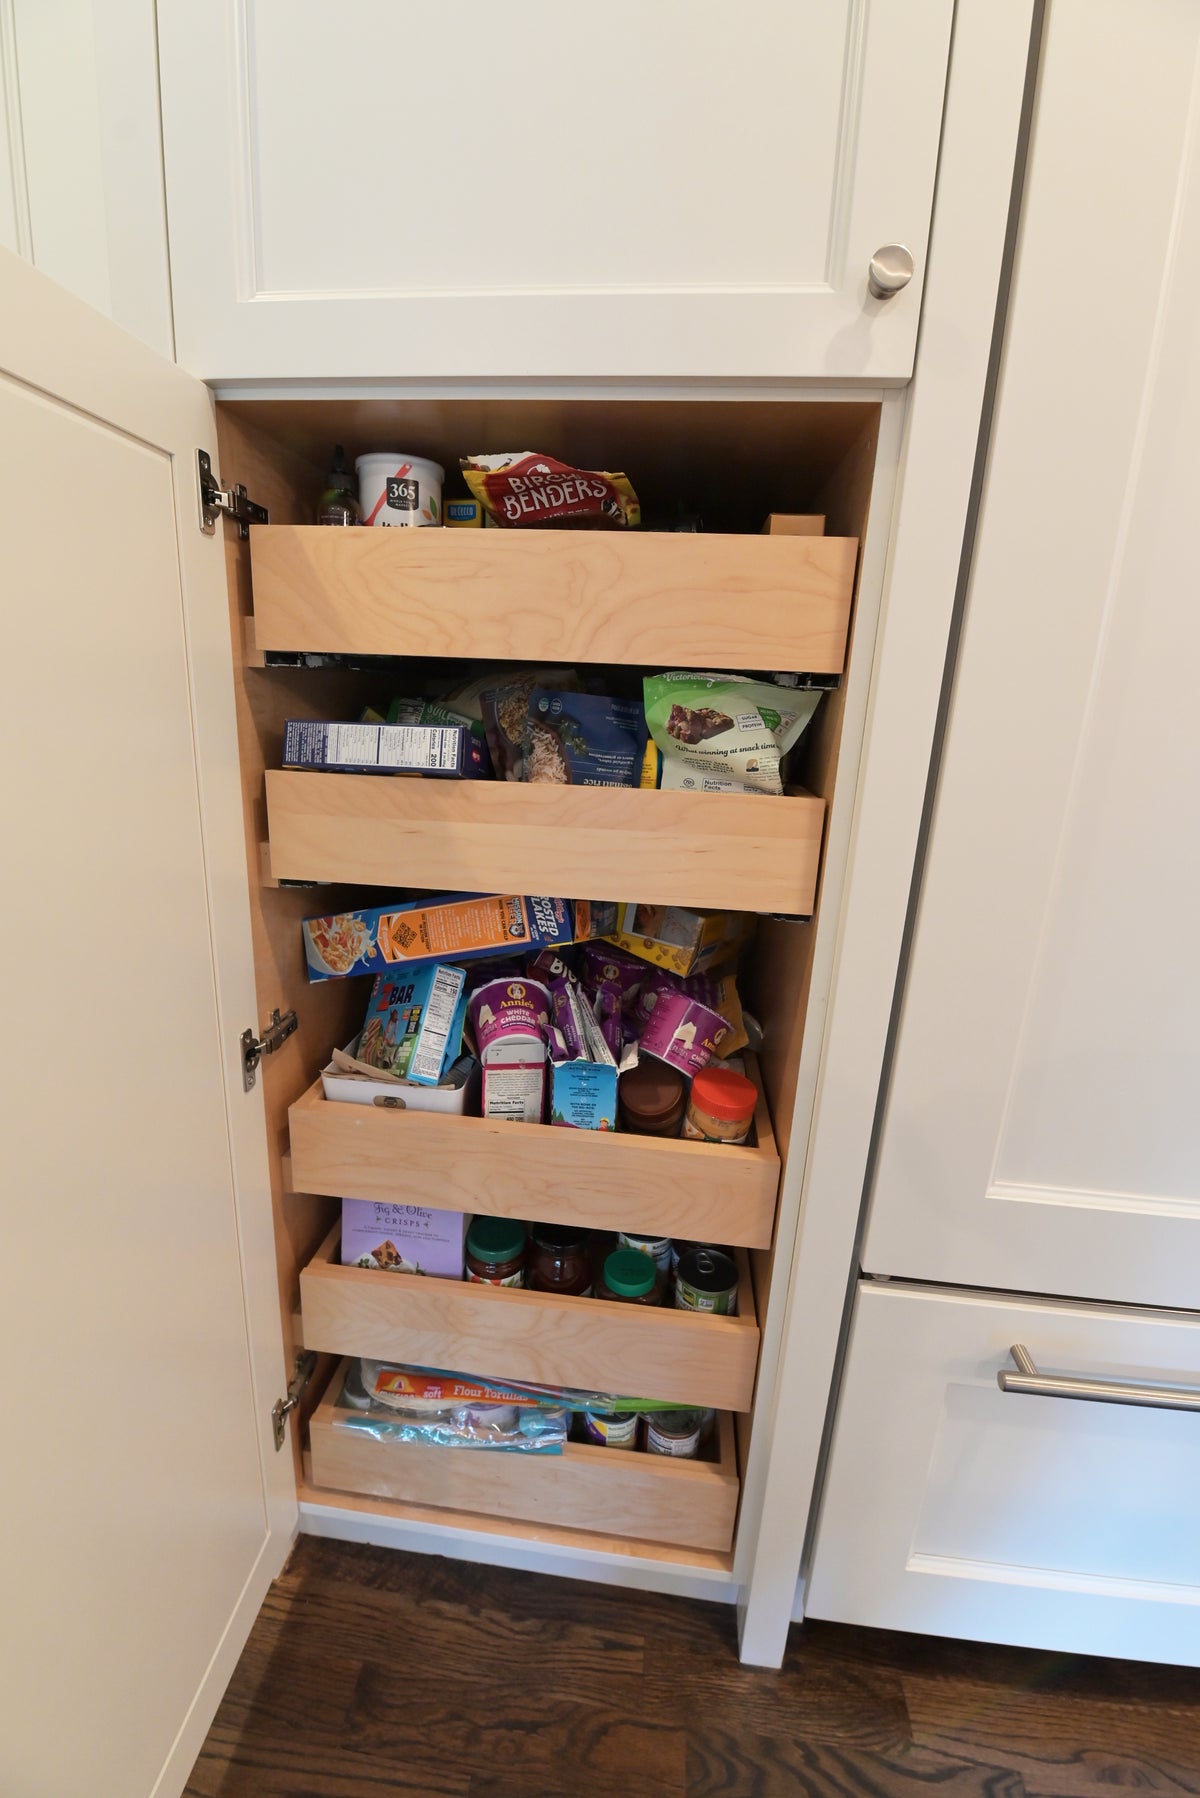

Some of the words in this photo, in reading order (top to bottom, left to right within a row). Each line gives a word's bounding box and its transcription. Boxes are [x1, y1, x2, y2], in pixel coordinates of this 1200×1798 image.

[389, 482, 416, 500] 365
[502, 479, 608, 520] BENDERS
[699, 749, 729, 757] winning
[740, 743, 760, 753] snack
[513, 896, 523, 924] MISSION
[531, 896, 549, 933] LAKES
[500, 999, 535, 1009] Annie's
[373, 1202, 391, 1216] Fig
[392, 1203, 404, 1215] &
[406, 1205, 433, 1219] Olive
[384, 1217, 421, 1227] CRISPS
[423, 1389, 443, 1398] soft
[453, 1385, 483, 1398] Flour
